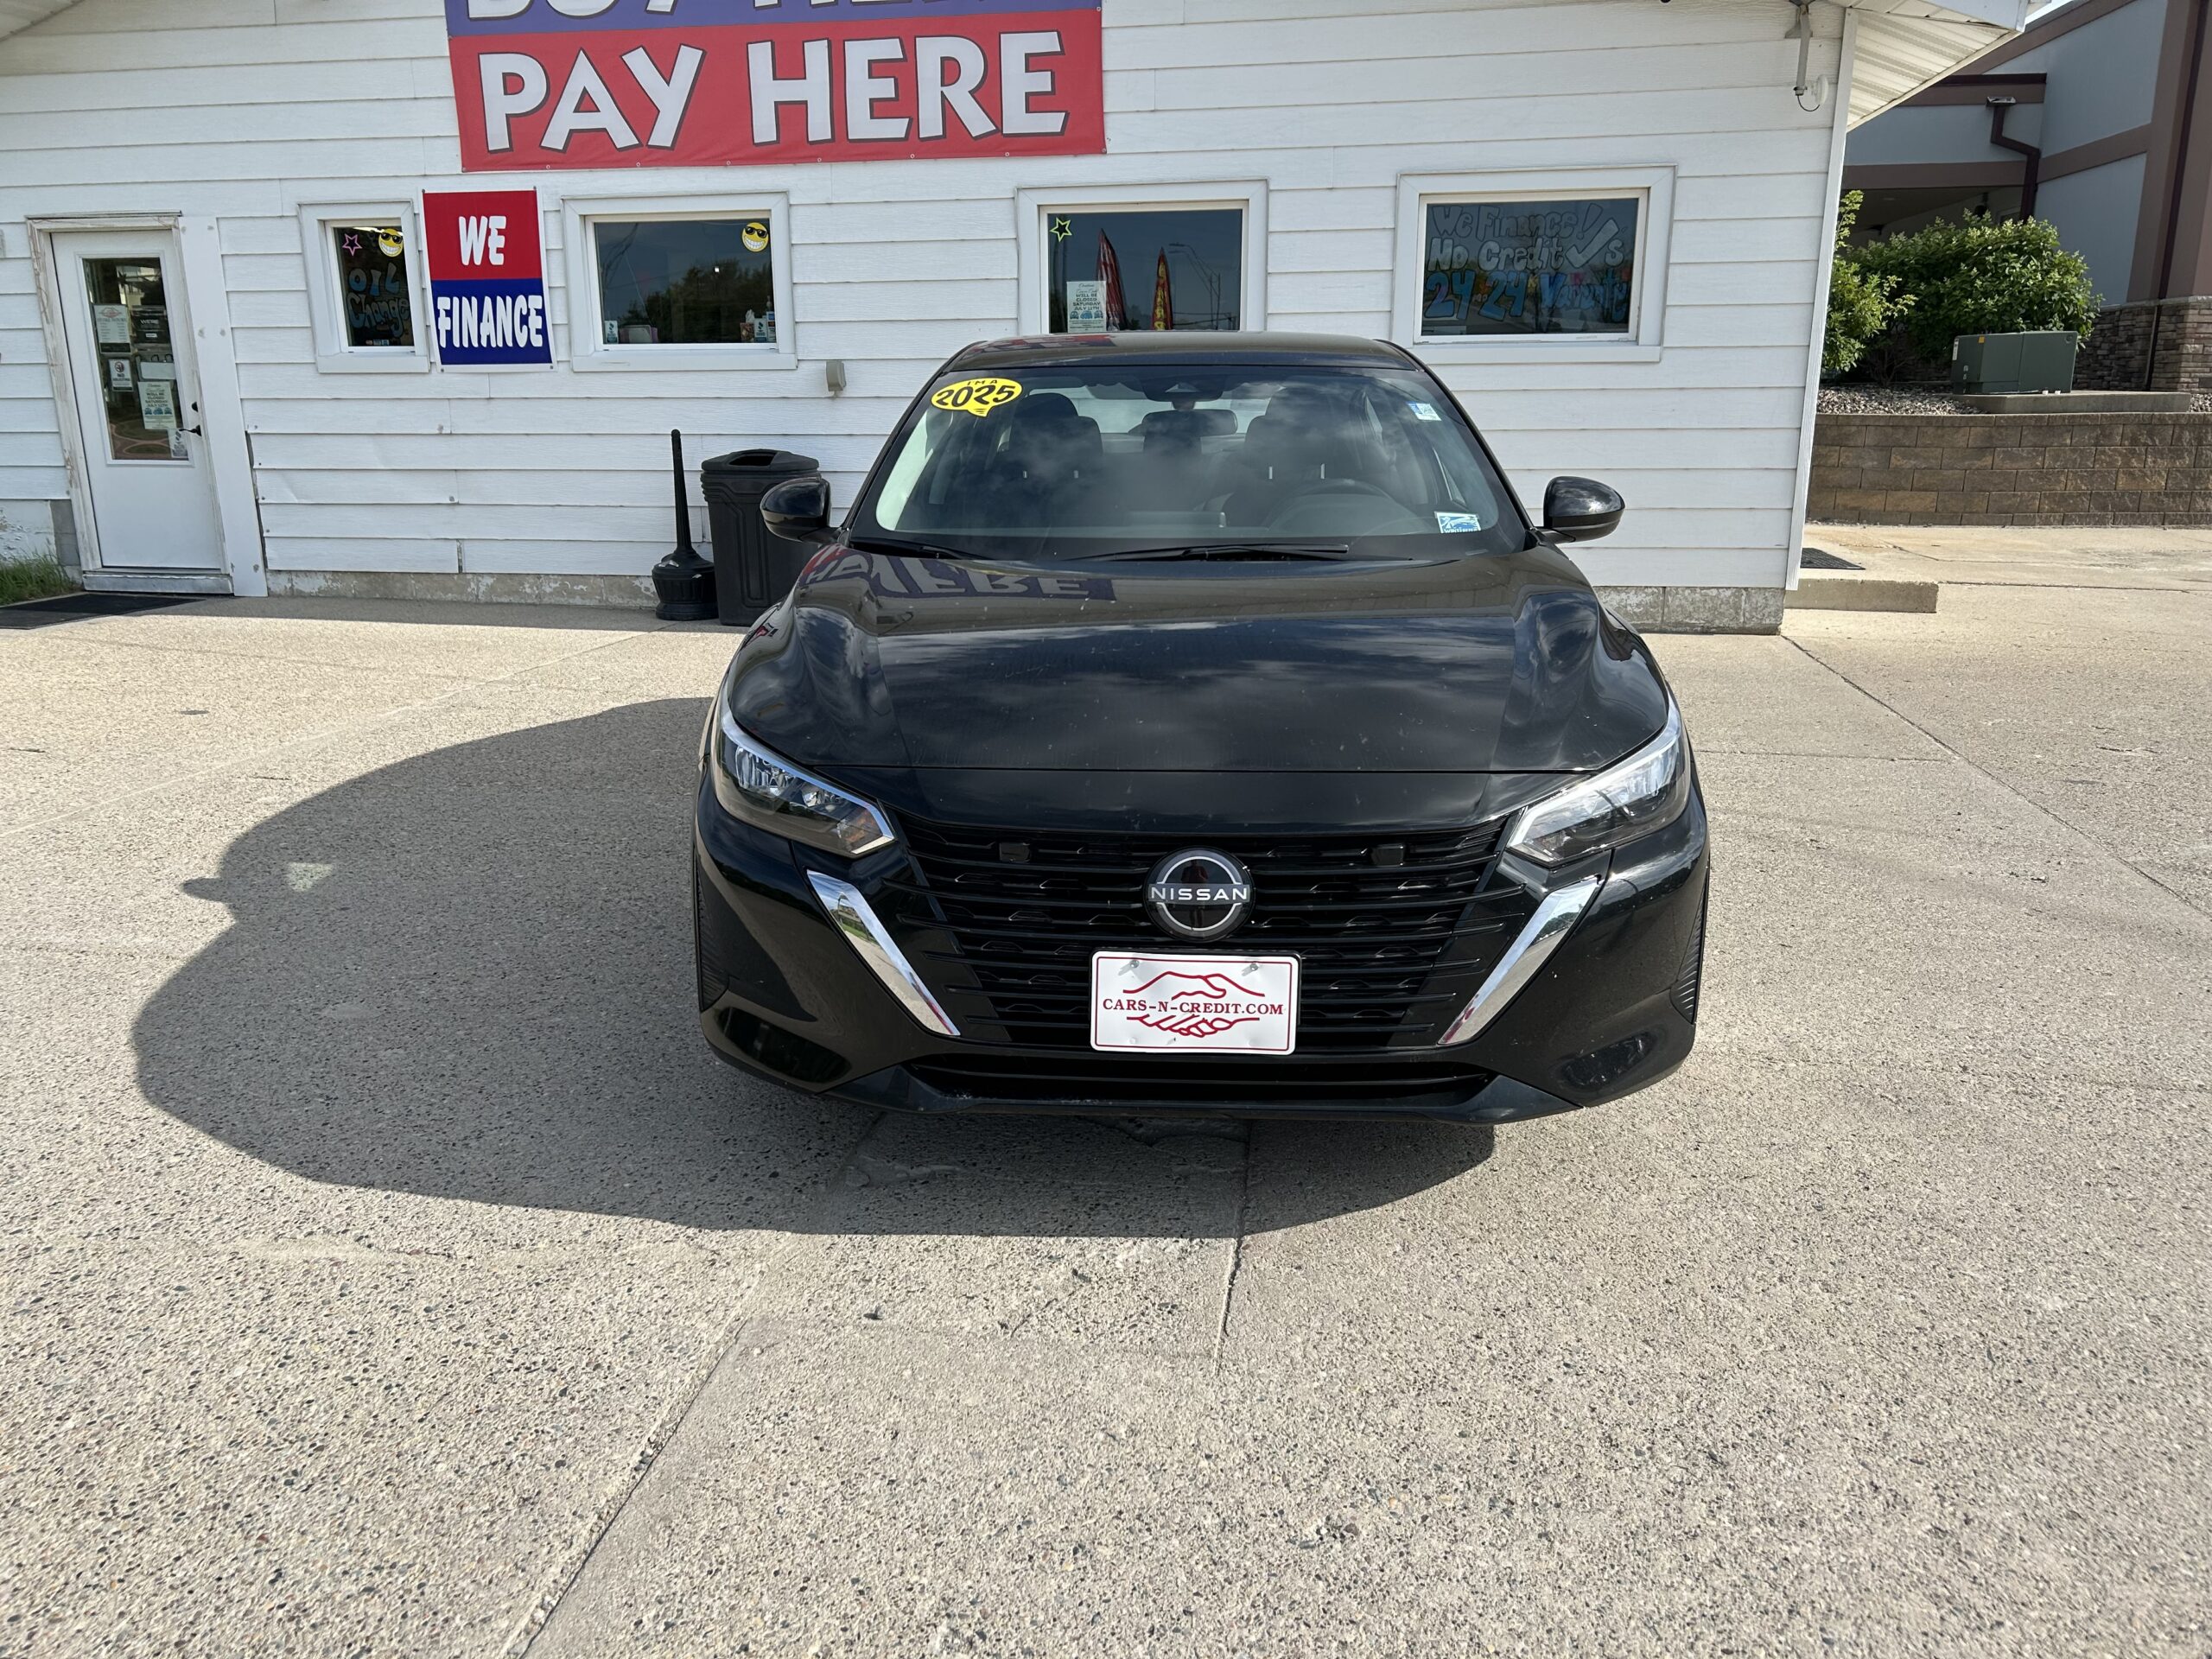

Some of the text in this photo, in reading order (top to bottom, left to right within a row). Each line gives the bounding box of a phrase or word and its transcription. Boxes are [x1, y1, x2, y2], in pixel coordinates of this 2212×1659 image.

[478, 29, 1070, 154] PAY HERE
[1432, 205, 1473, 238] We
[459, 215, 506, 266] WE
[1427, 237, 1469, 271] No
[1478, 234, 1566, 271] Credit
[1424, 269, 1476, 320] 24
[1478, 270, 1529, 321] 24
[437, 295, 543, 348] FINANCE
[936, 385, 1015, 407] 2025
[1151, 887, 1247, 901] NISSAN
[1103, 998, 1283, 1015] CARS-N-CREDIT.COM
